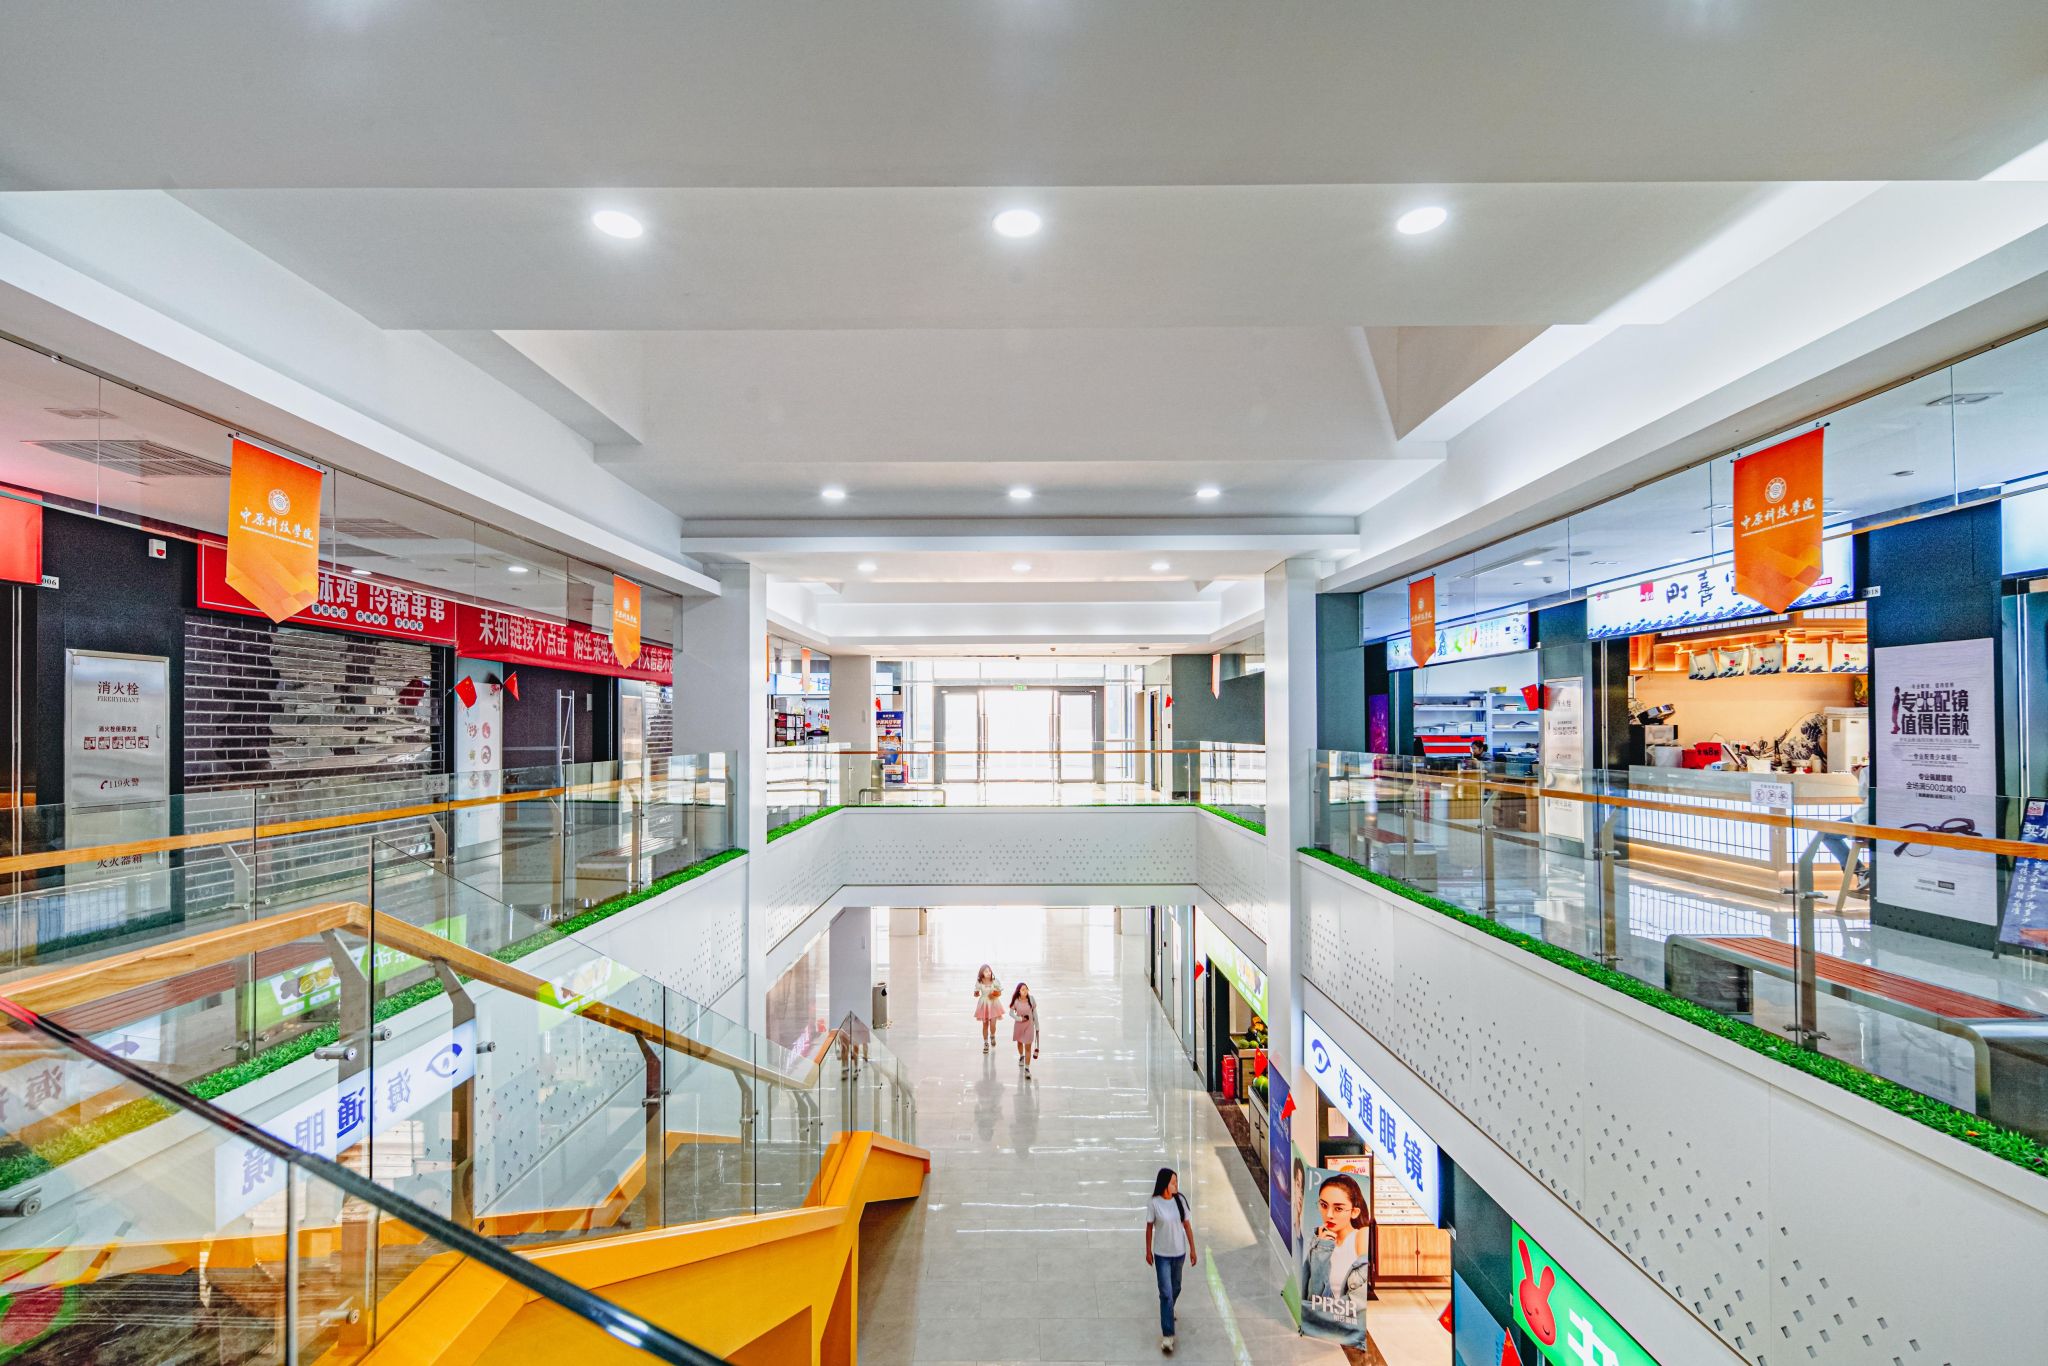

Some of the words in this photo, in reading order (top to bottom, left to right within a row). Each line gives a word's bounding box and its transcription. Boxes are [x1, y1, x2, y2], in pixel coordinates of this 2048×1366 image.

[479, 611, 568, 657] 未知链接不点击
[98, 681, 139, 695] 消火栓
[1900, 690, 1969, 713] 专业配镜
[1901, 713, 1969, 736] 值得信赖
[1339, 1063, 1424, 1193] 海通眼镜
[1312, 1294, 1357, 1318] PRSR
